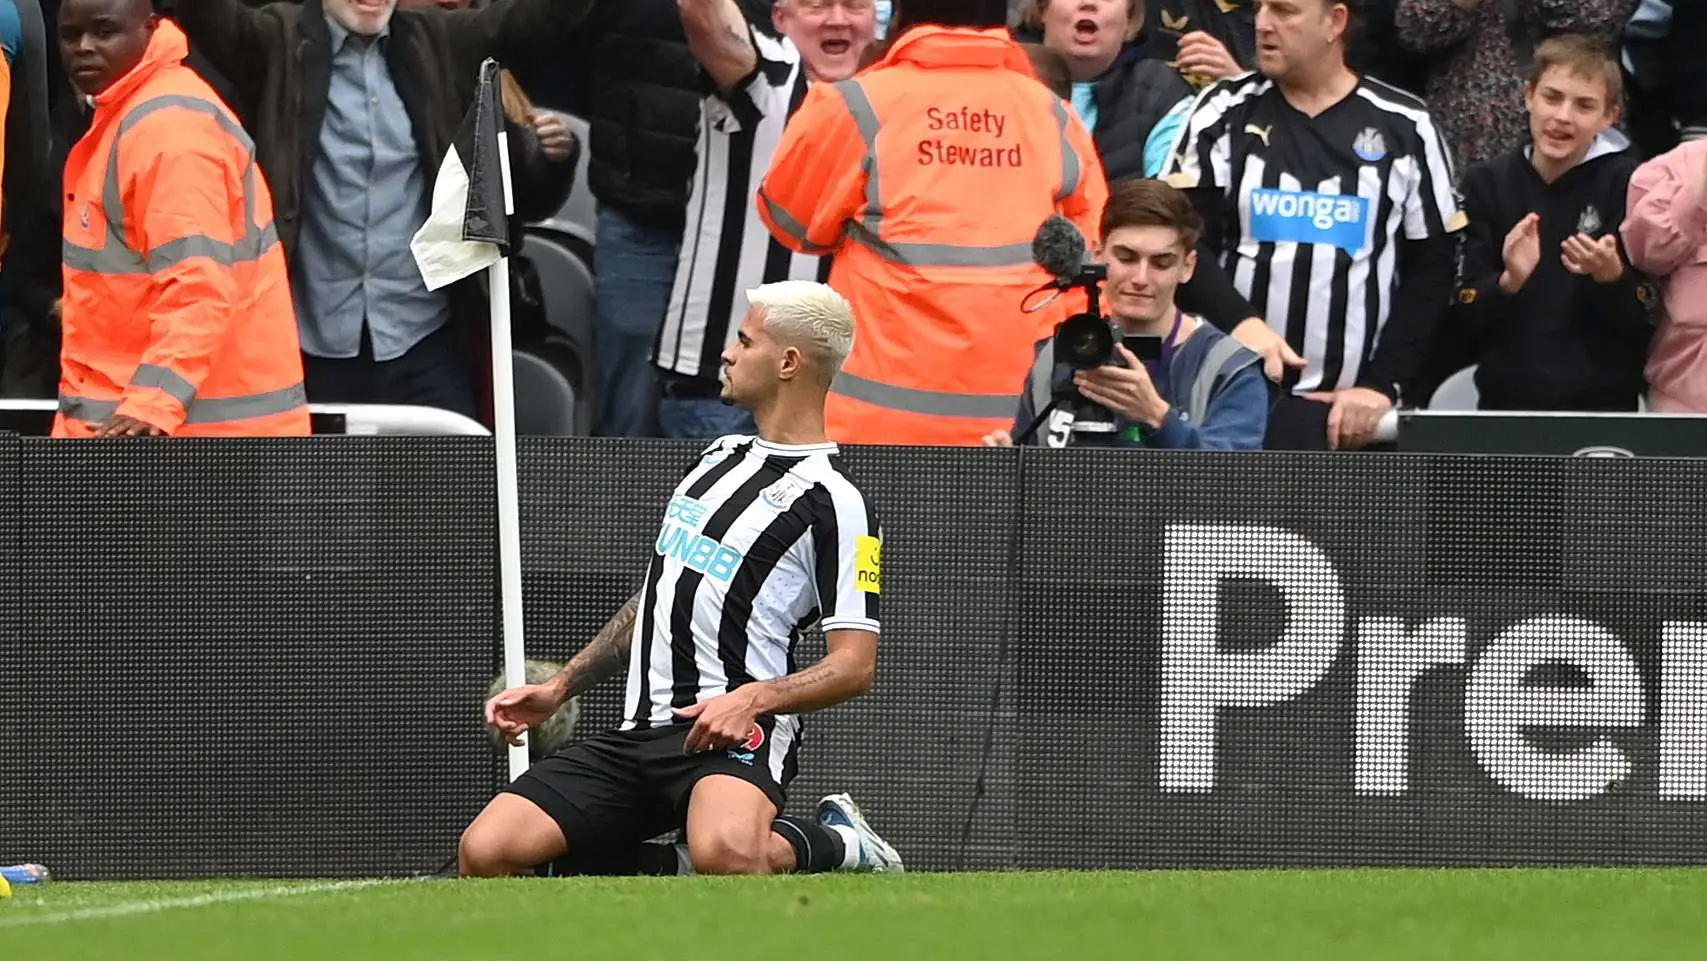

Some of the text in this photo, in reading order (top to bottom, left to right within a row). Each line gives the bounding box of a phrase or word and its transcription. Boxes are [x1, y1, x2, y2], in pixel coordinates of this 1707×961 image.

[927, 106, 1005, 139] Safety
[918, 139, 1022, 168] Steward
[1252, 192, 1352, 230] wonga
[658, 524, 741, 582] UN88
